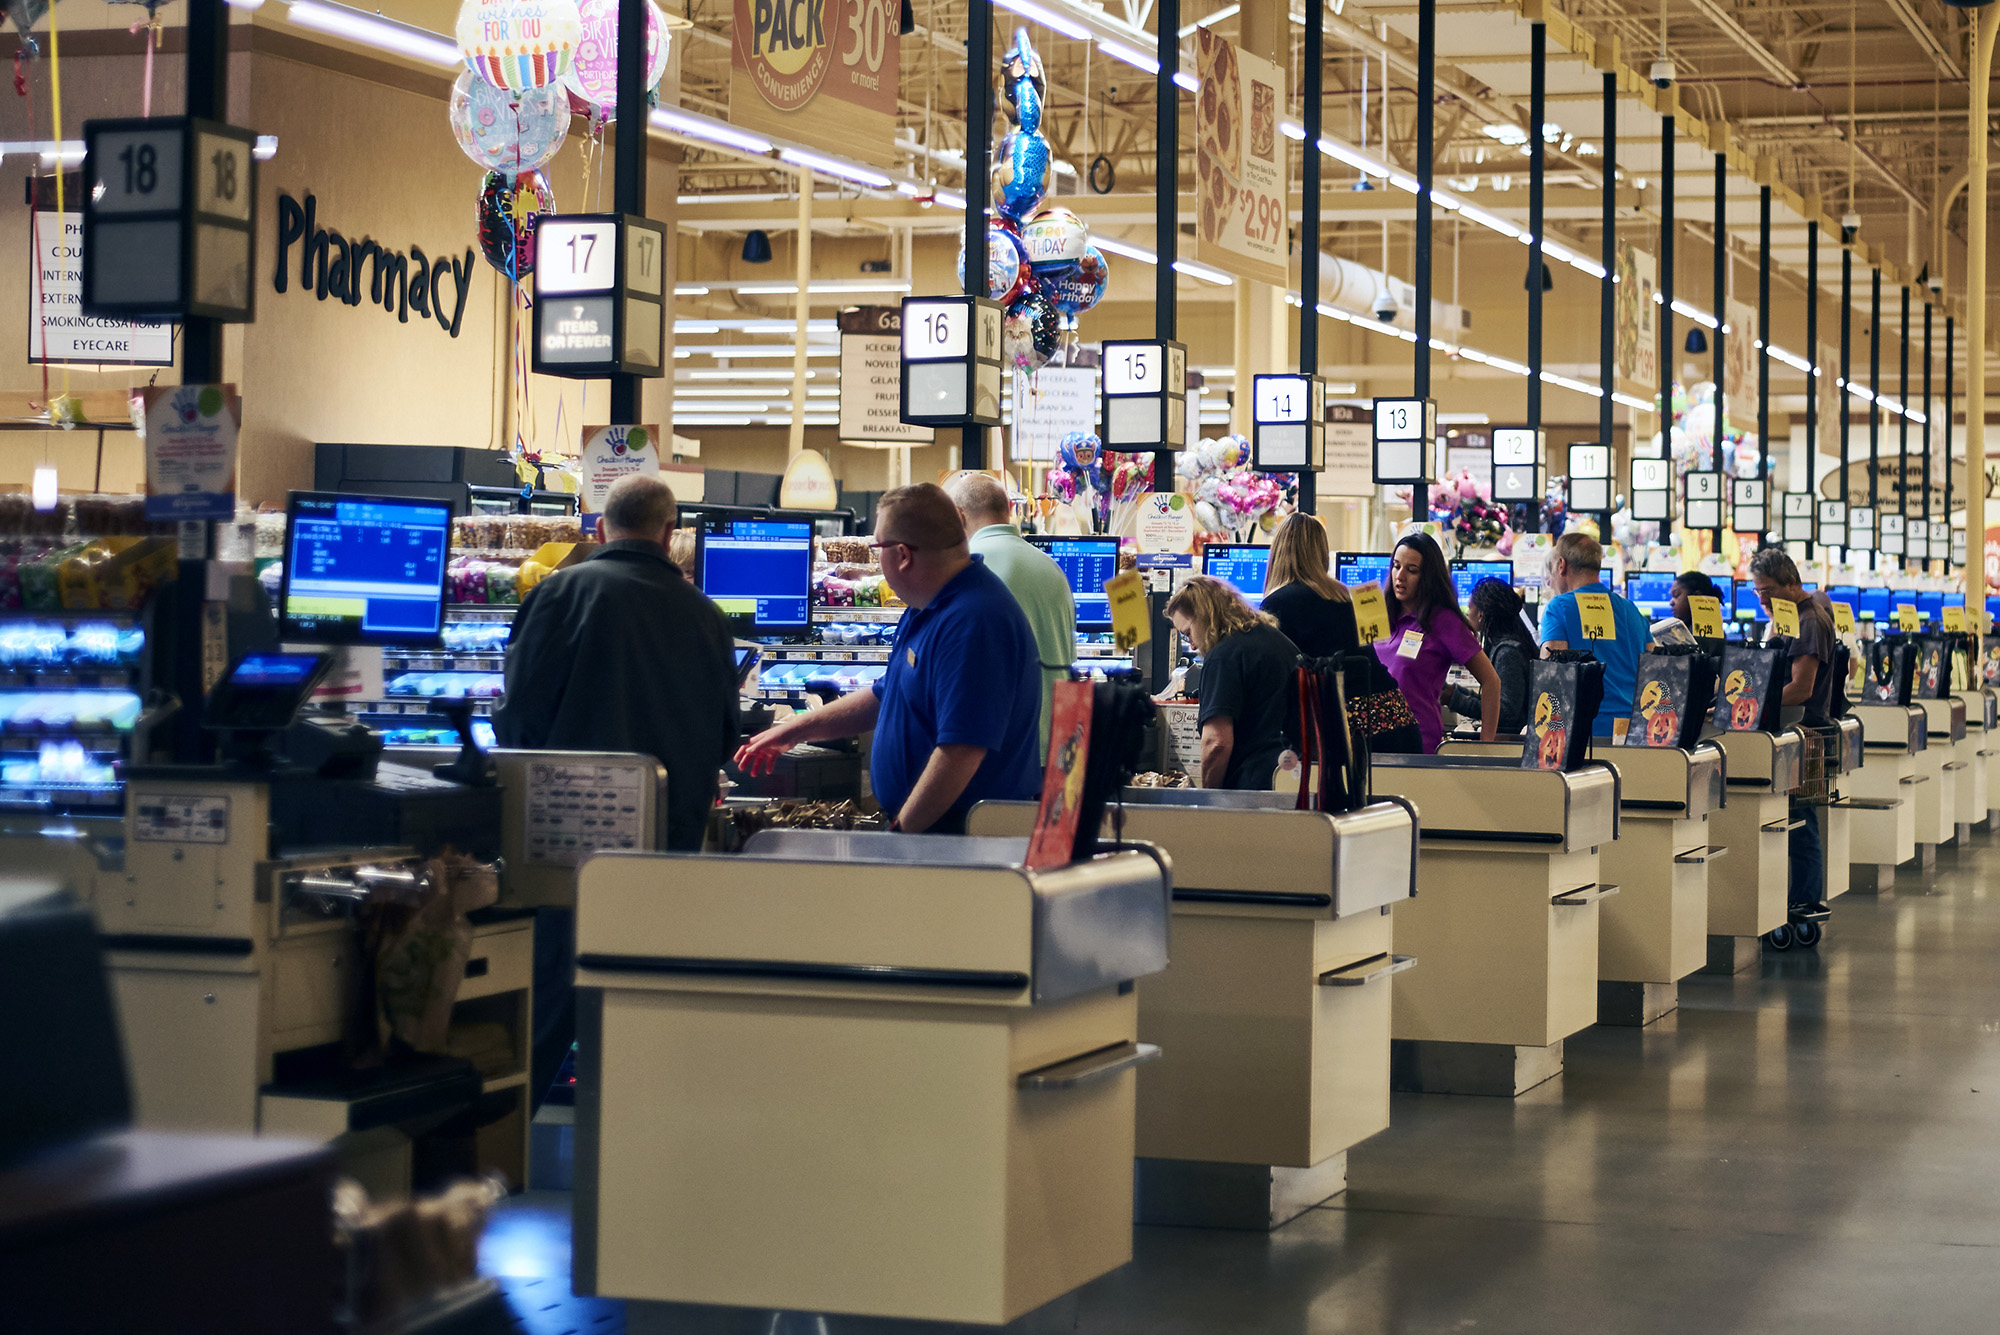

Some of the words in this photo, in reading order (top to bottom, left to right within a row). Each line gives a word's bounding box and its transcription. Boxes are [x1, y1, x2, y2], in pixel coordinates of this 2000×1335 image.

[478, 5, 548, 21] wishes
[485, 20, 509, 41] FOR
[514, 18, 541, 39] YOU
[753, 0, 826, 57] PACK
[842, 0, 899, 73] 30%
[757, 52, 824, 101] CONVENIENCE
[851, 71, 859, 84] or
[859, 73, 880, 91] more!
[119, 143, 158, 195] 18
[211, 149, 237, 200] 18
[1240, 187, 1282, 245] $2.99
[65, 224, 83, 235] PH
[52, 246, 82, 258] COU
[567, 234, 598, 274] 17
[638, 235, 655, 277] 17
[275, 194, 475, 338] Pharmacy
[43, 270, 83, 281] INTERN
[1059, 280, 1096, 294] Happy
[42, 293, 82, 305] EXTERN
[1058, 291, 1098, 304] irthday
[573, 306, 584, 320] 7
[41, 316, 94, 328] SMOKING
[559, 320, 598, 334] ITEMS
[924, 312, 949, 344] 16
[983, 313, 995, 347] 16
[73, 339, 129, 351] EYECARE
[546, 336, 566, 349] OR
[567, 335, 611, 349] FEWER
[865, 344, 879, 353] ICE
[881, 344, 901, 353] CRE
[865, 359, 900, 369] NOVELT
[1125, 353, 1146, 381] 15
[1272, 394, 1292, 418] 14
[1390, 408, 1407, 430] 13
[863, 424, 912, 434] BREAKFAST
[1508, 436, 1522, 455] 12
[1583, 454, 1595, 472] 11
[1642, 465, 1656, 481] 10
[1701, 477, 1708, 493] 9
[1745, 485, 1753, 499] 8
[1796, 497, 1803, 511] 7
[1829, 504, 1836, 518] 6
[1858, 511, 1865, 524] 5
[1890, 517, 1896, 530] 4
[1914, 522, 1920, 534] 3
[1935, 525, 1941, 537] 2
